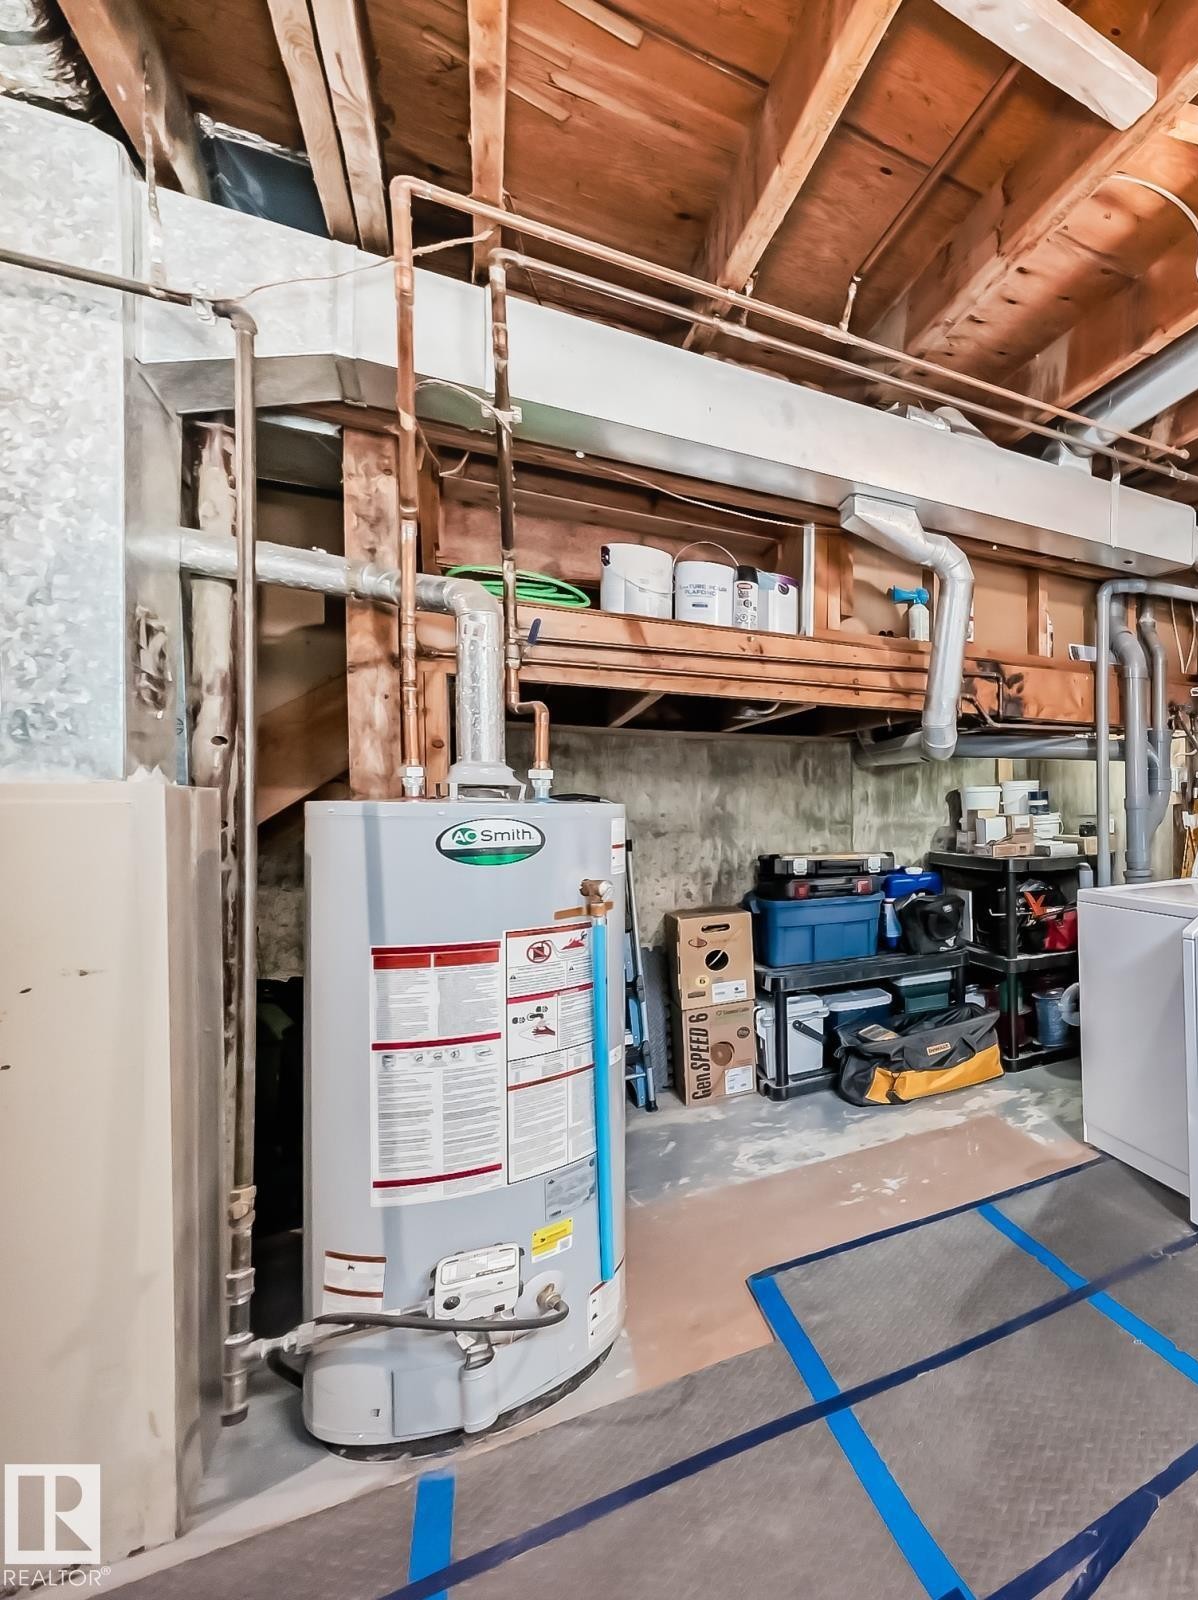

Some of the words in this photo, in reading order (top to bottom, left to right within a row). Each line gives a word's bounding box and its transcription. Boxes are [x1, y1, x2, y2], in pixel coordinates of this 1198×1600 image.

[480, 828, 532, 842] Smith
[688, 1012, 709, 1023] 6
[688, 1027, 712, 1100] GenSPEED
